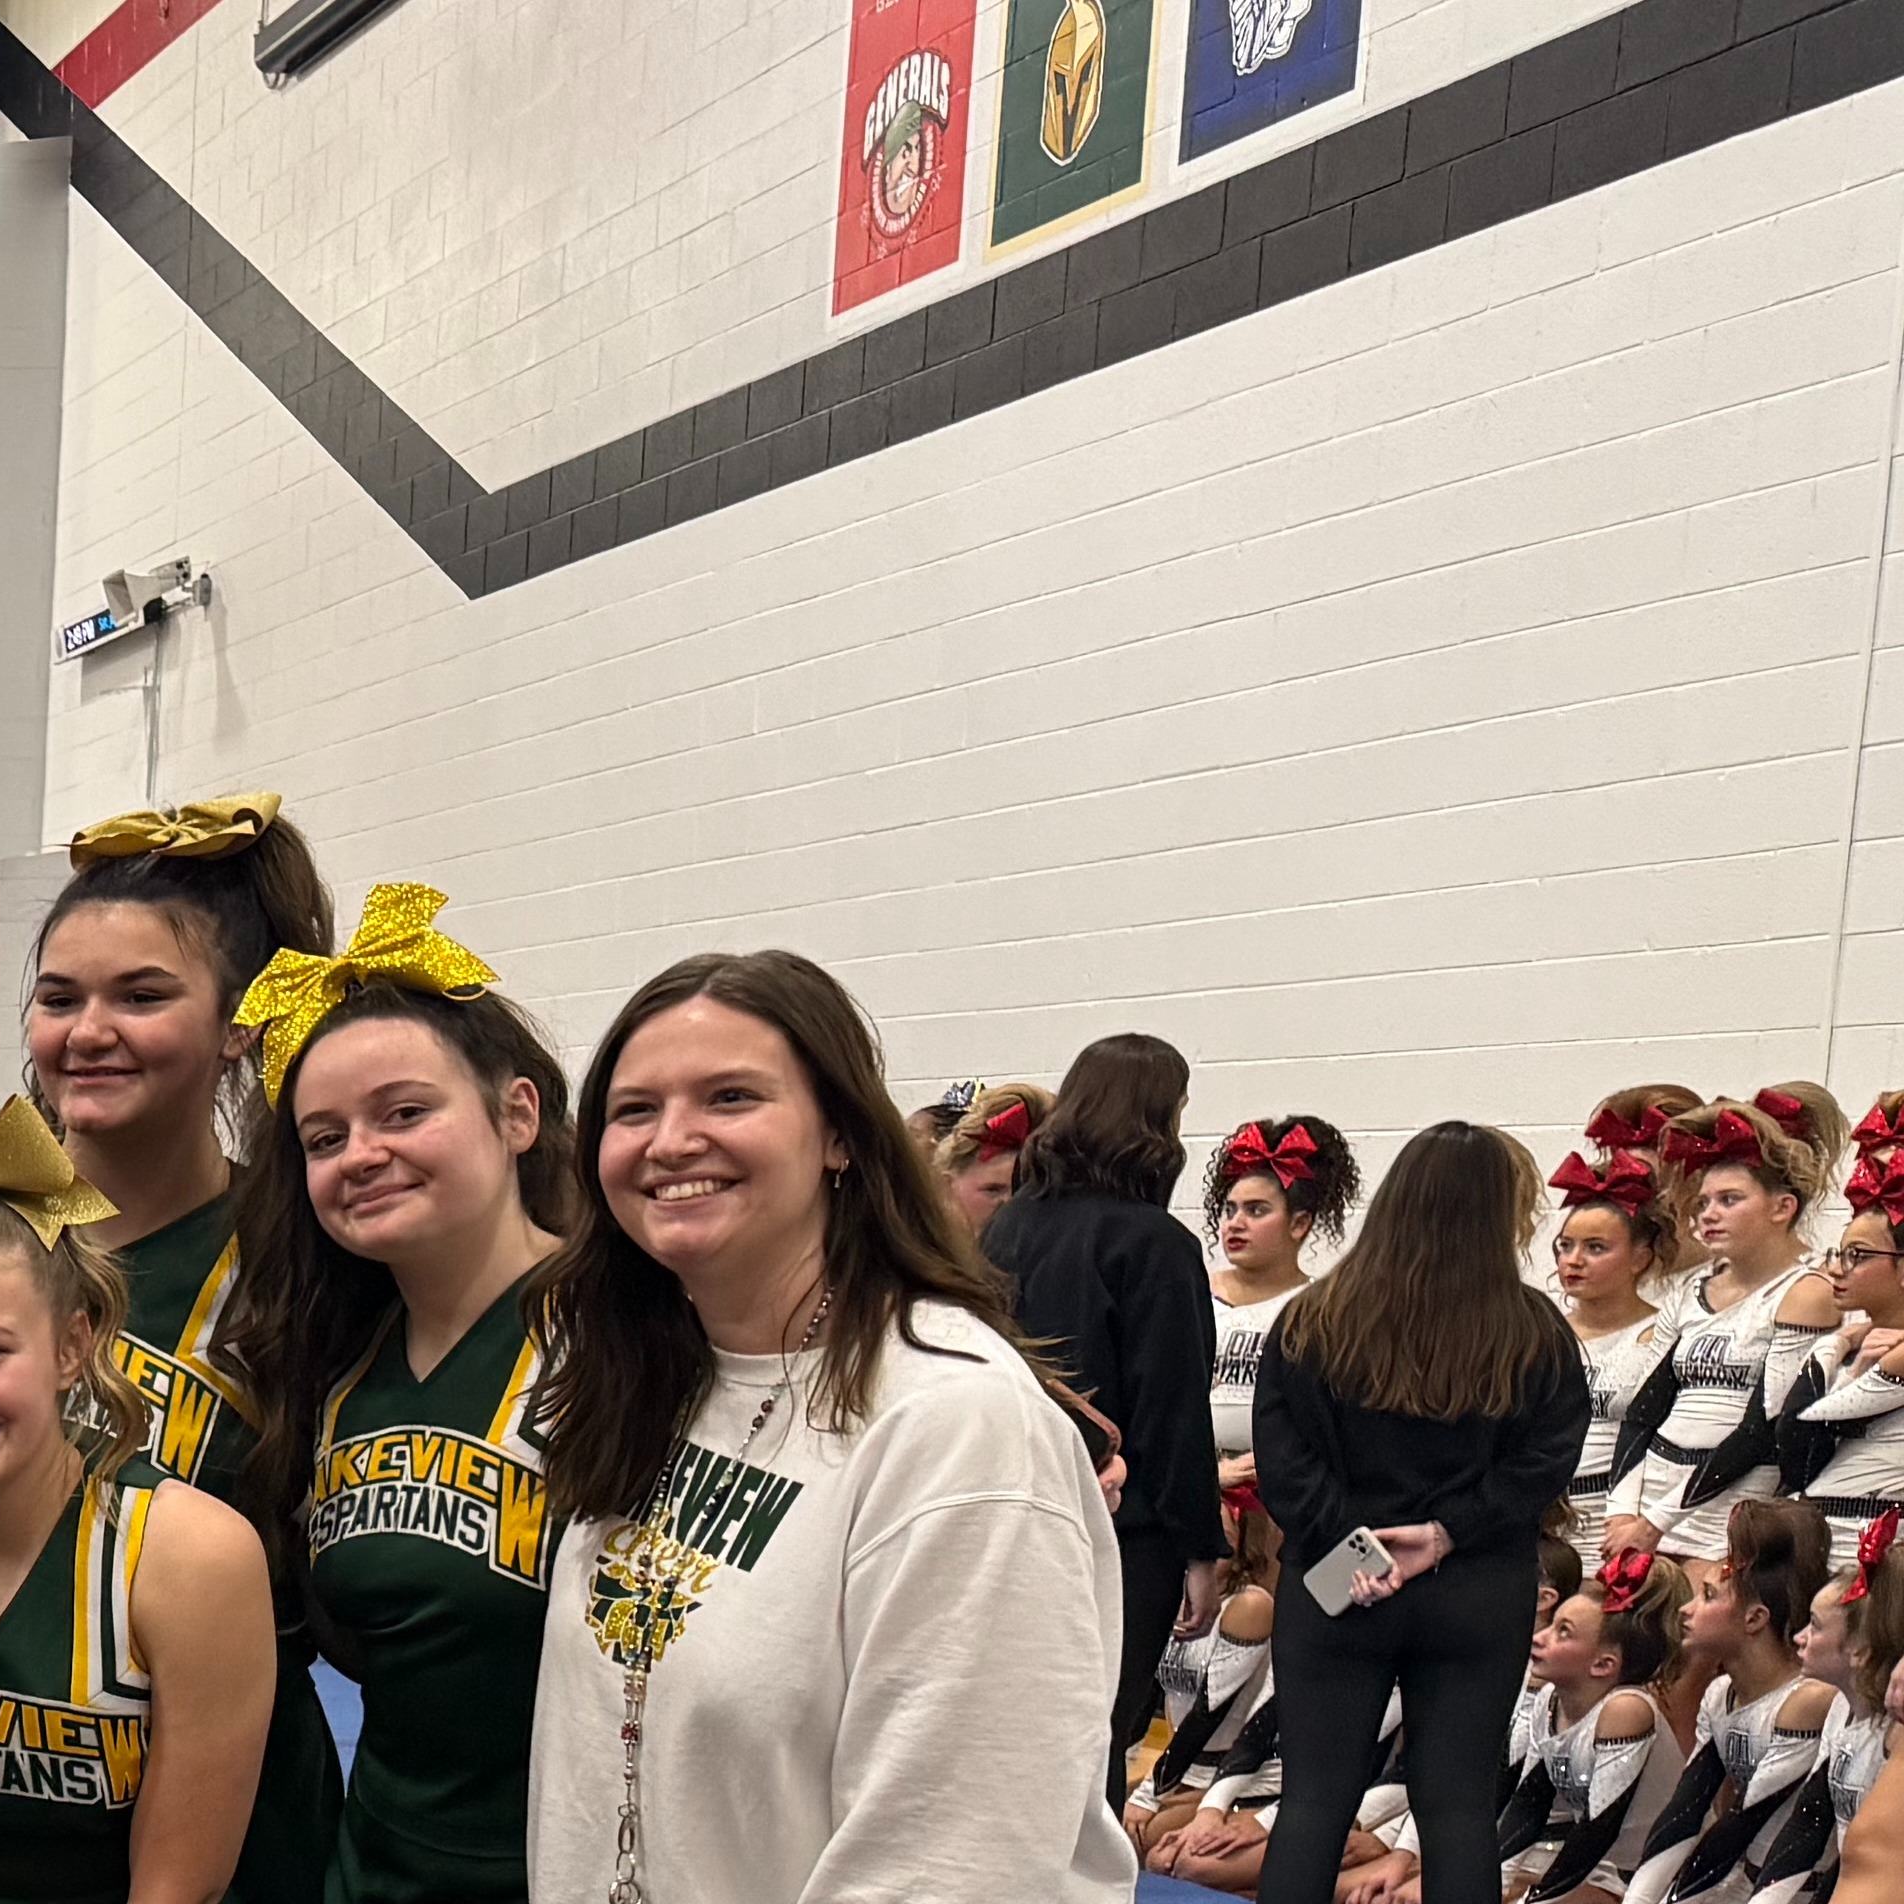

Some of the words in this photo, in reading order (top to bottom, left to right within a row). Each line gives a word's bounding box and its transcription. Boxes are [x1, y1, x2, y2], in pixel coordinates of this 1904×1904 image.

[863, 51, 952, 162] GENERALS
[310, 1425, 548, 1591] AKEVIEW
[314, 1484, 489, 1556] SPARTANS
